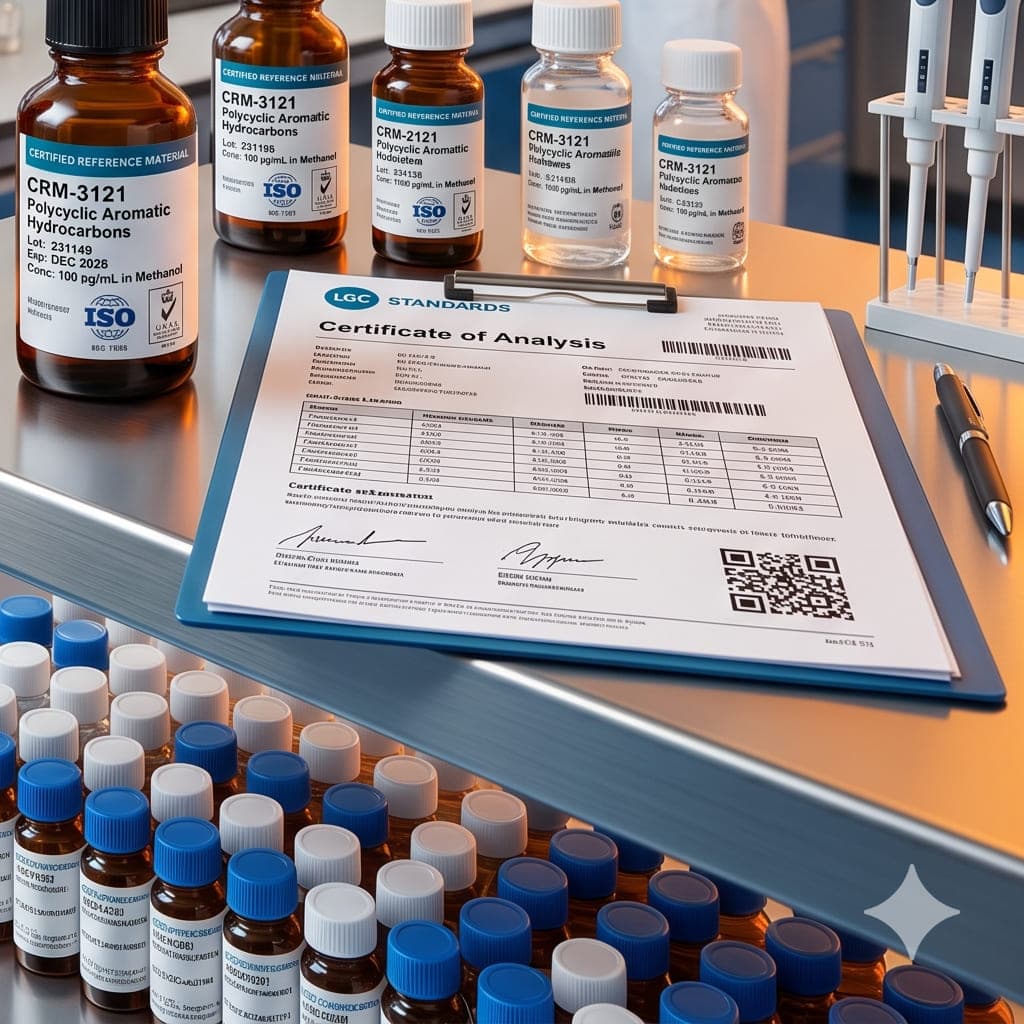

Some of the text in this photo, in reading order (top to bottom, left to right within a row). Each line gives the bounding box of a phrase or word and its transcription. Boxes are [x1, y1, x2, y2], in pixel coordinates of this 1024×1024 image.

[222, 68, 257, 81] CERTIFIED
[222, 90, 296, 110] CRM-3121
[222, 107, 330, 125] Polycyclic Aromatic
[222, 120, 298, 137] Hydrocarbons
[376, 125, 437, 143] CRM-2121
[376, 139, 420, 155] Polycyclic
[528, 129, 589, 147] CRM-3121
[29, 147, 189, 167] CERTIFIED REFERENCE MATERIAL
[244, 153, 259, 163] 100
[289, 156, 298, 164] in
[658, 158, 716, 175] CRM-3121
[27, 176, 126, 202] CRM-3121
[263, 182, 302, 198] ISO
[27, 197, 171, 222] Polycyclic Aromatic
[412, 205, 446, 218] ISO
[27, 215, 131, 239] Hydrocarbons
[27, 235, 92, 256] Lot: 231149
[51, 255, 76, 268] DEC
[27, 263, 55, 279] Conc:
[59, 270, 78, 281] 100
[122, 271, 133, 283] in
[135, 264, 183, 283] Methanol
[334, 293, 511, 313] LGC STANDARDS
[84, 307, 136, 327] ISO
[319, 320, 606, 350] Certificate of Analysis
